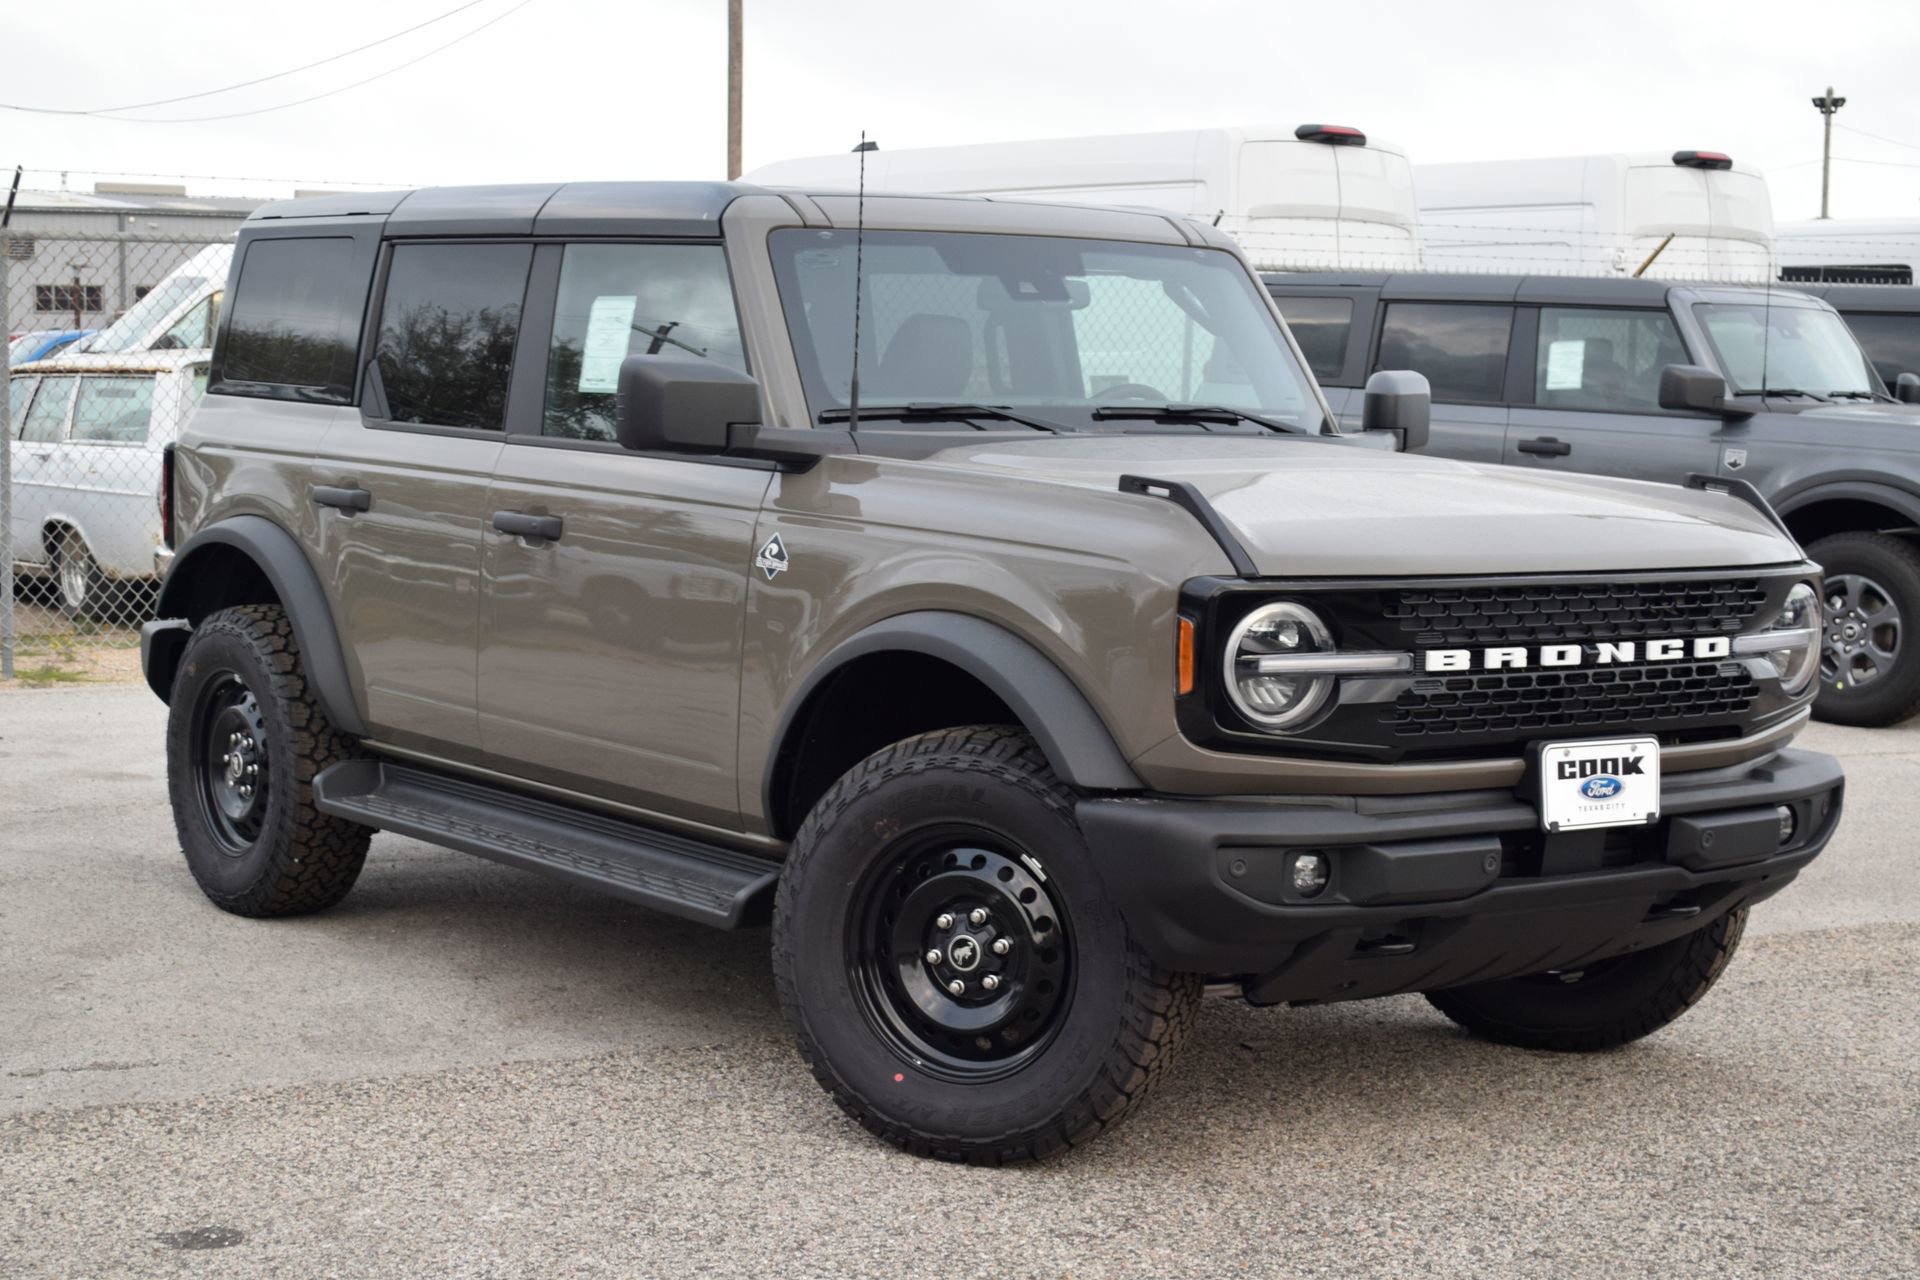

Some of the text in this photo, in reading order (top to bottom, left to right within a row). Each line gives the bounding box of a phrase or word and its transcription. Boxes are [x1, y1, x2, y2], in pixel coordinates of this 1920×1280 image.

[1425, 637, 1730, 671] BRONCO
[1558, 756, 1644, 779] COOK
[1586, 779, 1617, 797] Ford
